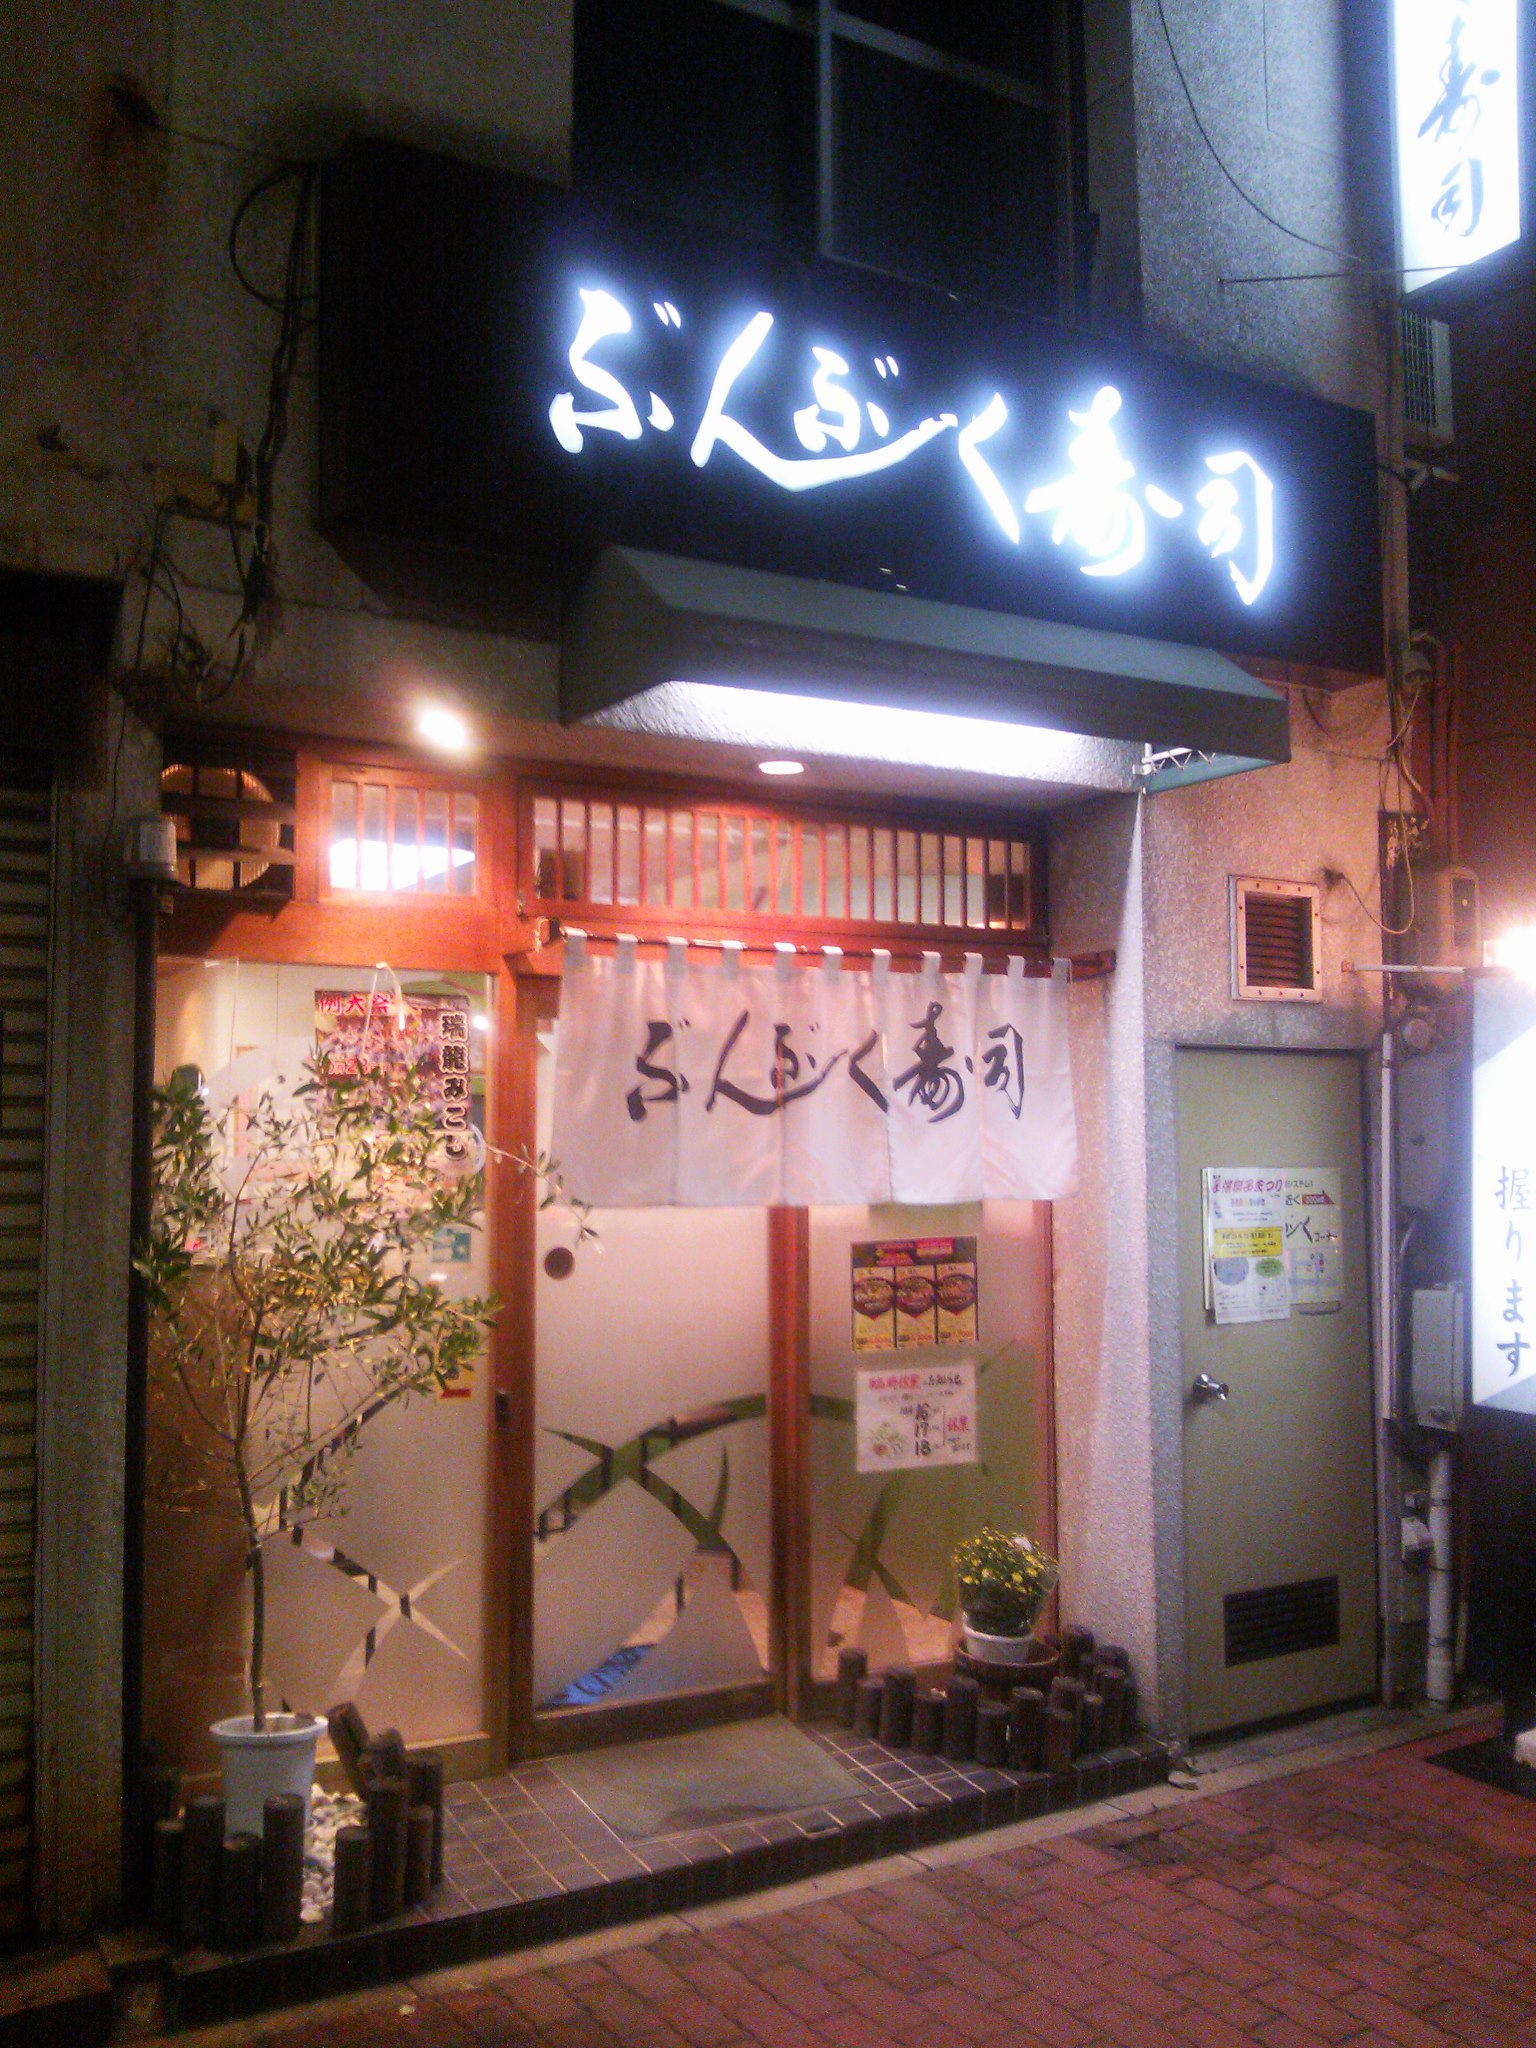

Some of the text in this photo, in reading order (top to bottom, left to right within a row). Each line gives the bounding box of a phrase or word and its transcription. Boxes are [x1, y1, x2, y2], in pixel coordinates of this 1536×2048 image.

[1417, 0, 1501, 237] 寿司
[548, 288, 1274, 605] ぶんぶく寿司
[319, 993, 392, 1016] 例大祭
[626, 1000, 1026, 1124] ぶんぶく寿司
[1494, 1165, 1534, 1377] 握ります
[914, 1439, 932, 1456] 18
